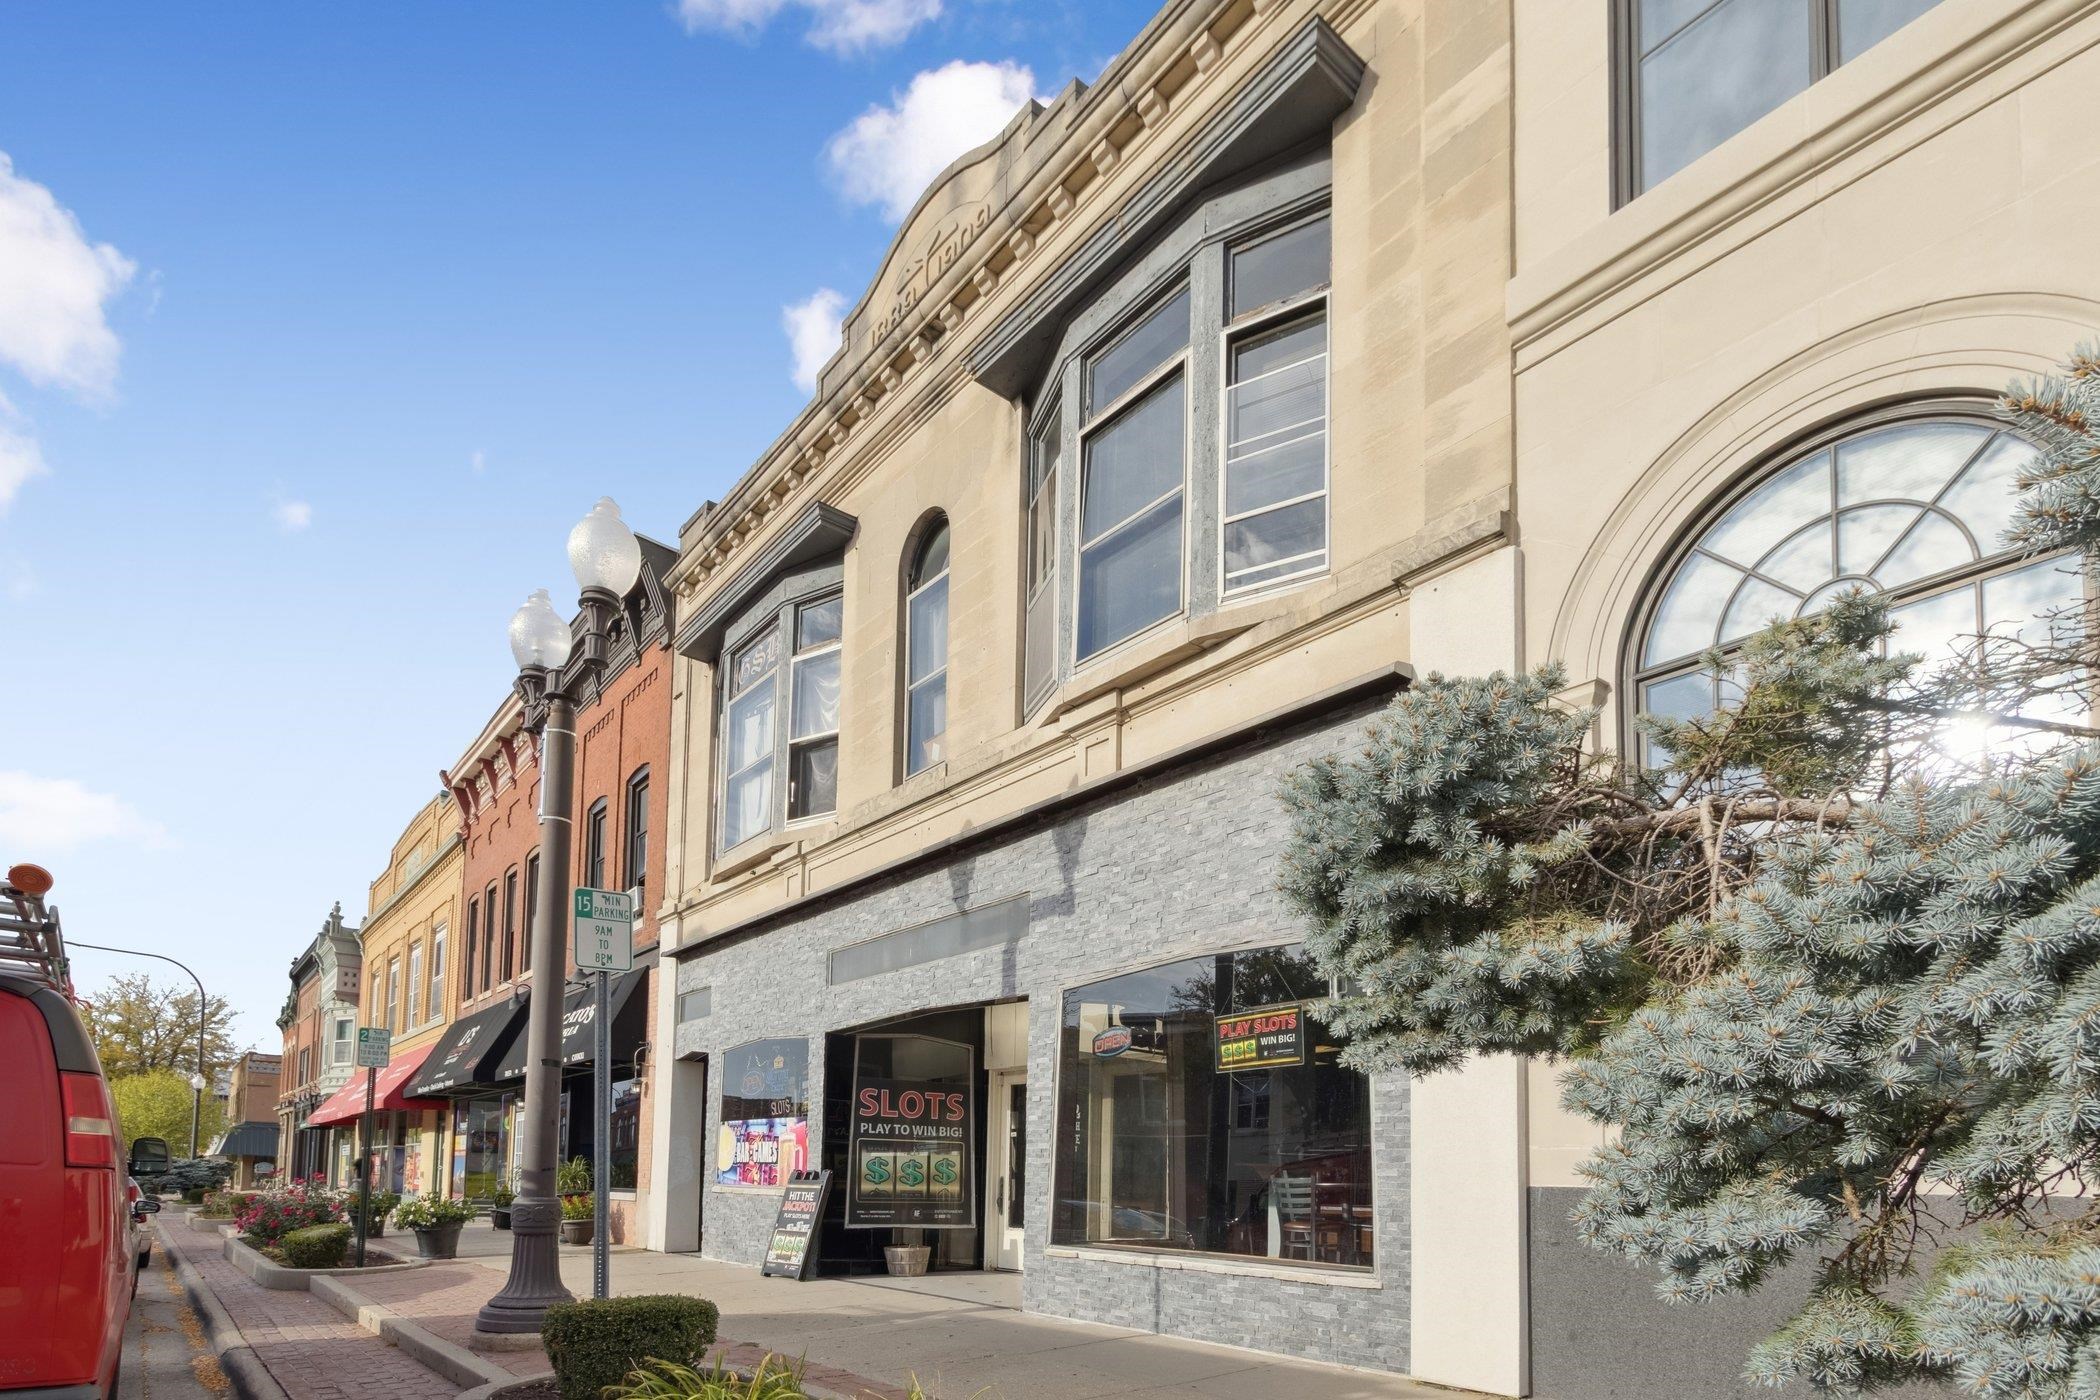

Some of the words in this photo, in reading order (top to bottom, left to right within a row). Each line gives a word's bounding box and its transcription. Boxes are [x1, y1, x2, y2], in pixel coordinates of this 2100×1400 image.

[577, 895, 591, 912] 15
[604, 895, 621, 906] MIN
[594, 906, 629, 920] PARKING
[595, 925, 613, 936] 9AM
[599, 939, 609, 950] TO
[595, 952, 613, 964] 8PM
[1220, 1020, 1252, 1039] PLAY
[1254, 1013, 1297, 1034] SLOTS
[360, 1030, 368, 1041] 2
[1260, 1036, 1277, 1045] WIN
[1278, 1033, 1296, 1043] BIG!
[1094, 1033, 1131, 1053] OPEN
[770, 1098, 790, 1116] SLOTS
[859, 1087, 965, 1121] SLOTS
[860, 1122, 891, 1134] PLAY
[893, 1124, 910, 1135] TO
[912, 1125, 936, 1136] WIN
[939, 1126, 963, 1137] BIG!
[736, 1141, 750, 1163] BAR
[753, 1141, 779, 1163] GAMES
[789, 1191, 801, 1201] HIT
[801, 1191, 815, 1201] THE
